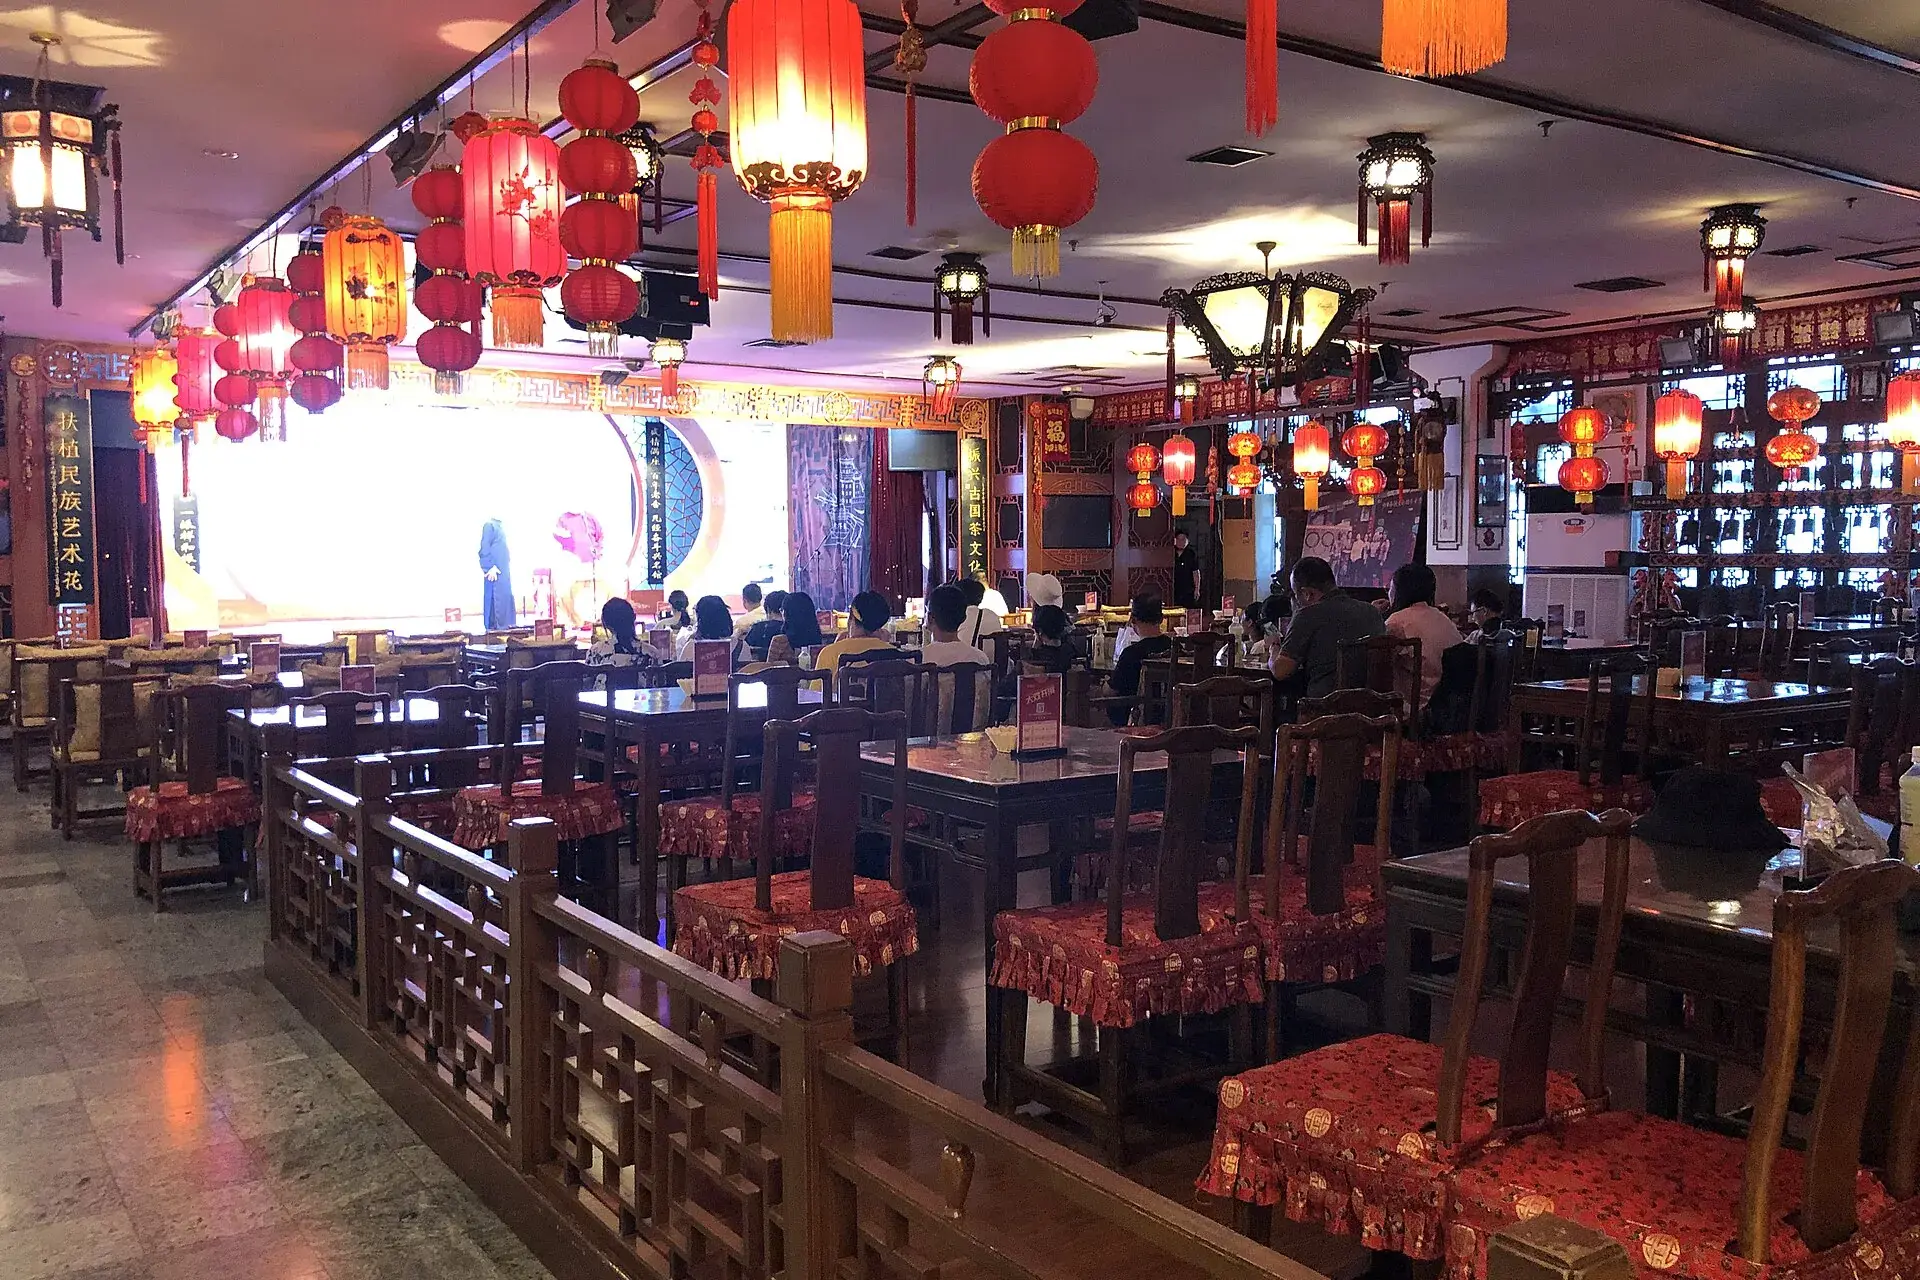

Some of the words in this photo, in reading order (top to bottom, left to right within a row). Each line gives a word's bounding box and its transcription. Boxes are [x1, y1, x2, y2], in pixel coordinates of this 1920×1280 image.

[1047, 420, 1065, 443] 福
[58, 411, 84, 591] 扶植民族艺术花
[968, 448, 984, 573] 振兴古国茶文化
